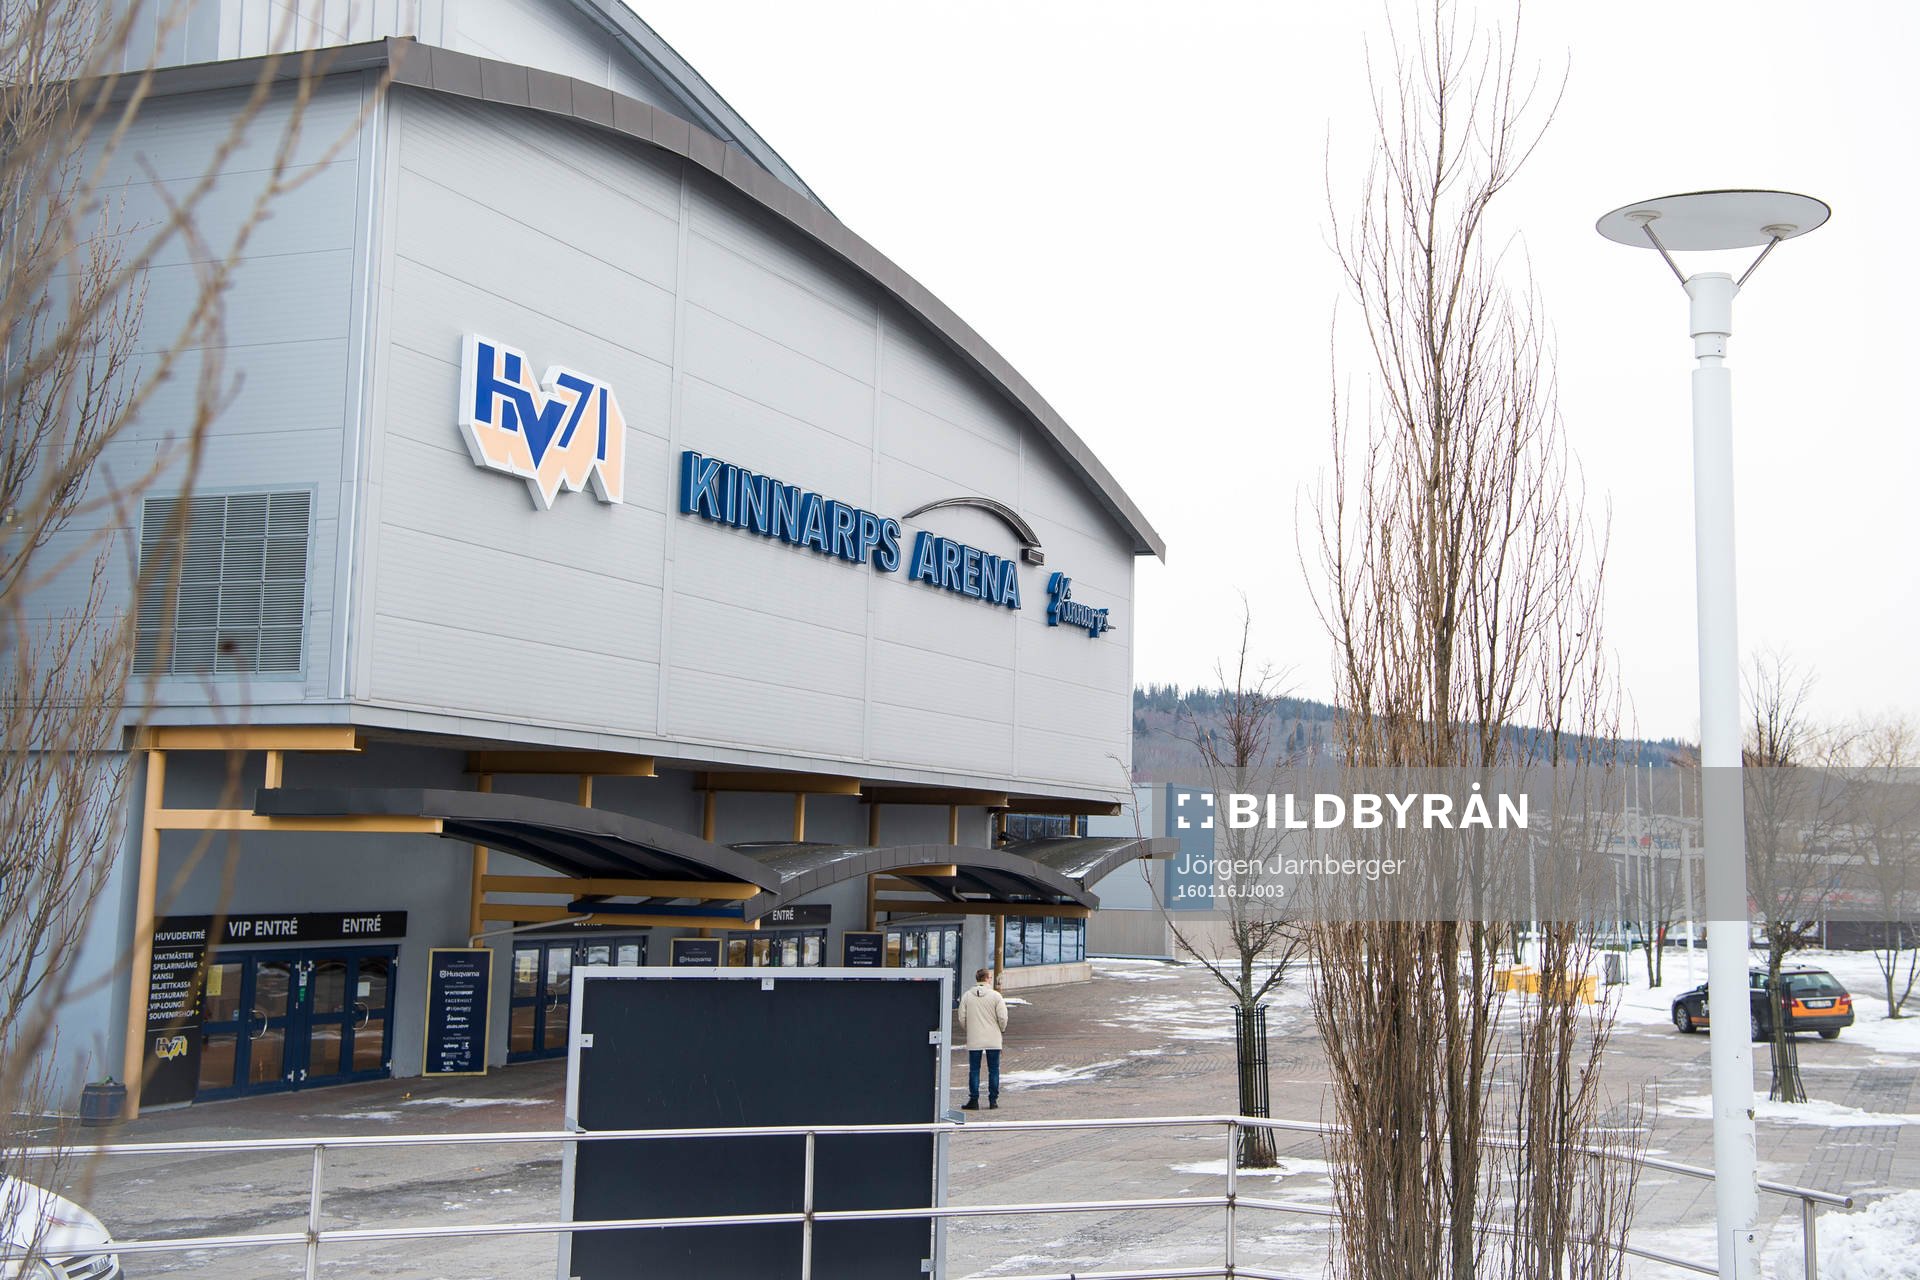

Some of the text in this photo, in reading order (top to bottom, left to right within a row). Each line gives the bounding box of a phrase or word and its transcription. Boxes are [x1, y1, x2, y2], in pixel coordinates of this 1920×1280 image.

[469, 336, 613, 475] HV71
[680, 450, 1022, 610] KINNARPS ARENA
[772, 906, 794, 921] ENTRÉ
[229, 917, 298, 937] VIP ENTRÉ
[342, 914, 382, 933] ENTRÉ
[155, 929, 206, 941] HUVUDENTRÉ
[152, 972, 174, 981] KANSLI
[150, 991, 189, 1000] RESTAURANG
[148, 1010, 195, 1020] SOUVENIRSHOP
